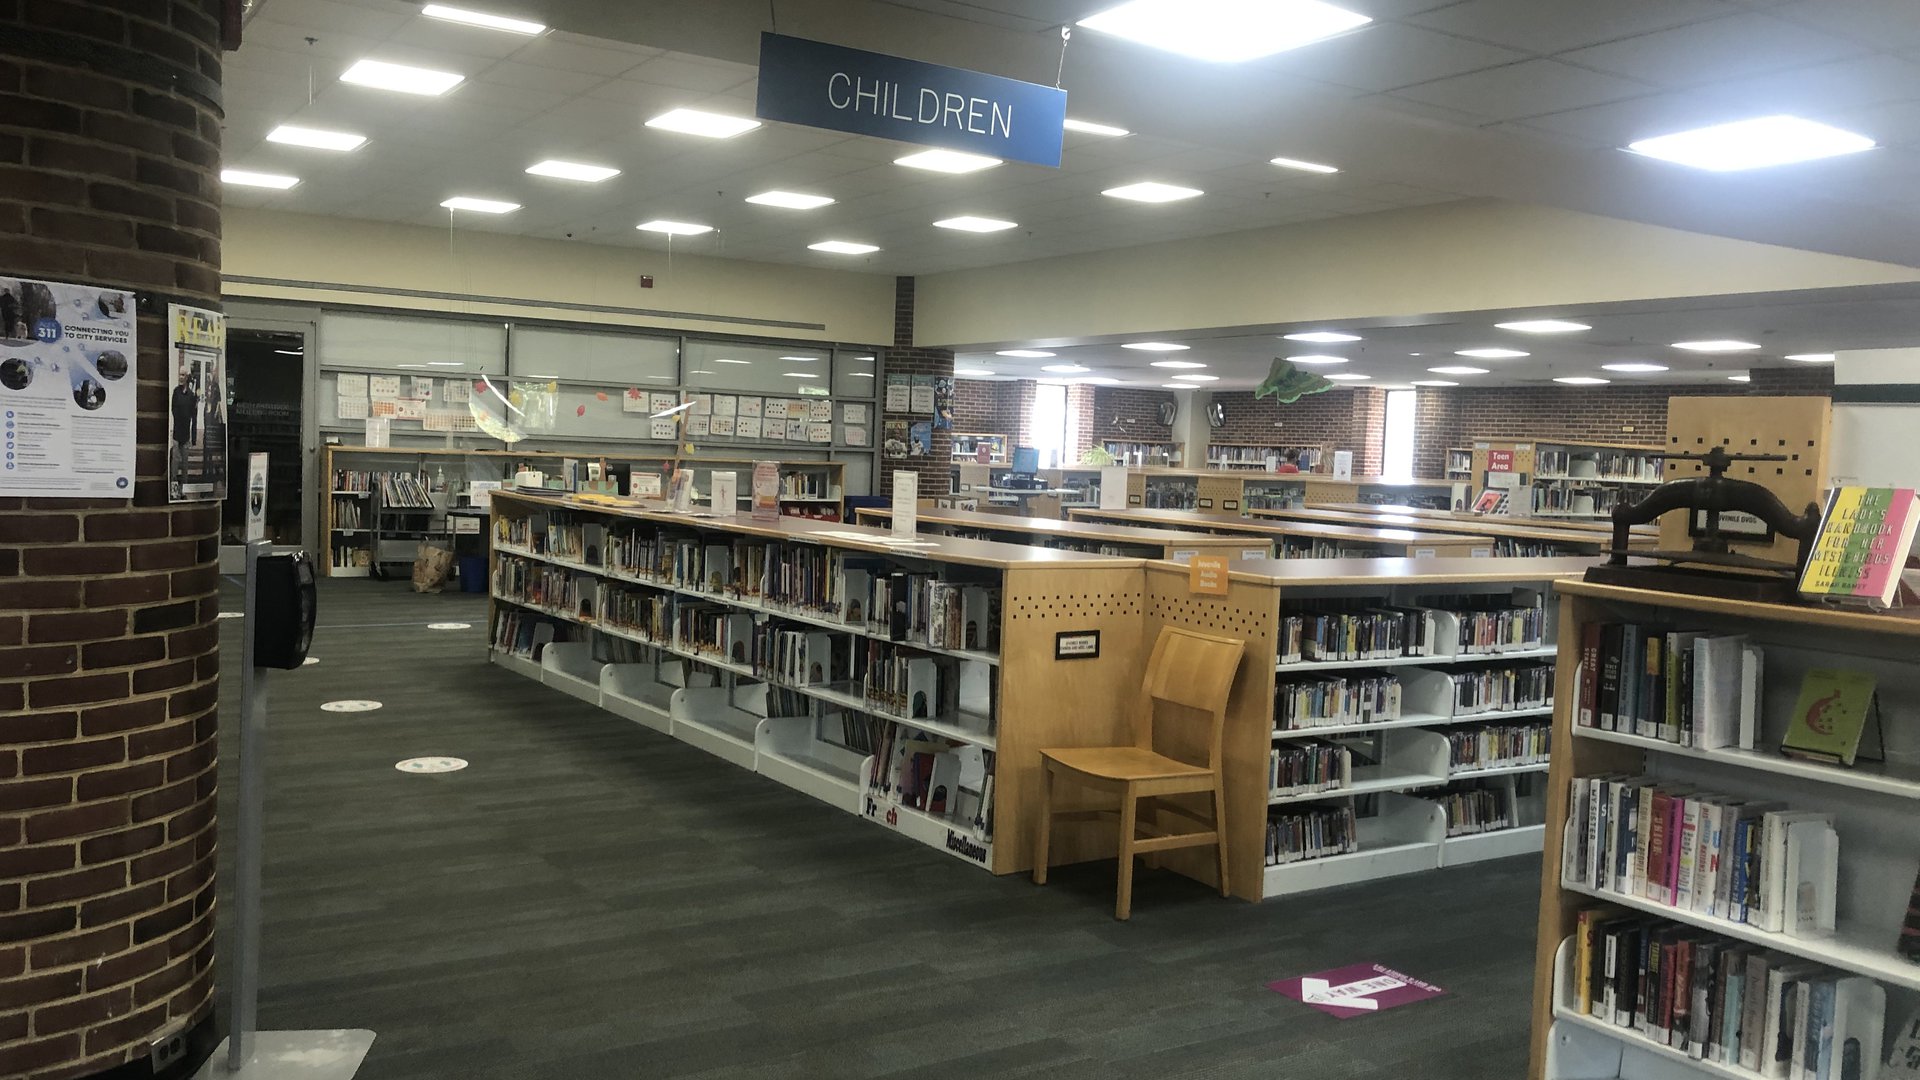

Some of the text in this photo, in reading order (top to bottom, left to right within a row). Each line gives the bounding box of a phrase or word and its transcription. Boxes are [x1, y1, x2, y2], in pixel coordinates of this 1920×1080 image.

[828, 72, 1012, 138] CHILDREN
[37, 327, 57, 338] 311
[64, 325, 129, 337] CONNECTING YOU
[76, 333, 94, 341] CITY
[95, 334, 128, 344] SERVICES
[1492, 452, 1510, 460] Teen
[1491, 462, 1509, 470] Area
[1858, 495, 1881, 506] THE
[1842, 508, 1887, 520] LADY'S
[1826, 522, 1893, 536] HANDBOOK
[1825, 537, 1884, 550] FOR HER
[1814, 550, 1889, 565] MYSTERIOUS
[1589, 789, 1597, 840] MY SISTER
[946, 828, 987, 863] Miscellaneous
[1365, 978, 1398, 990] ONE
[1325, 987, 1363, 999] WAY
